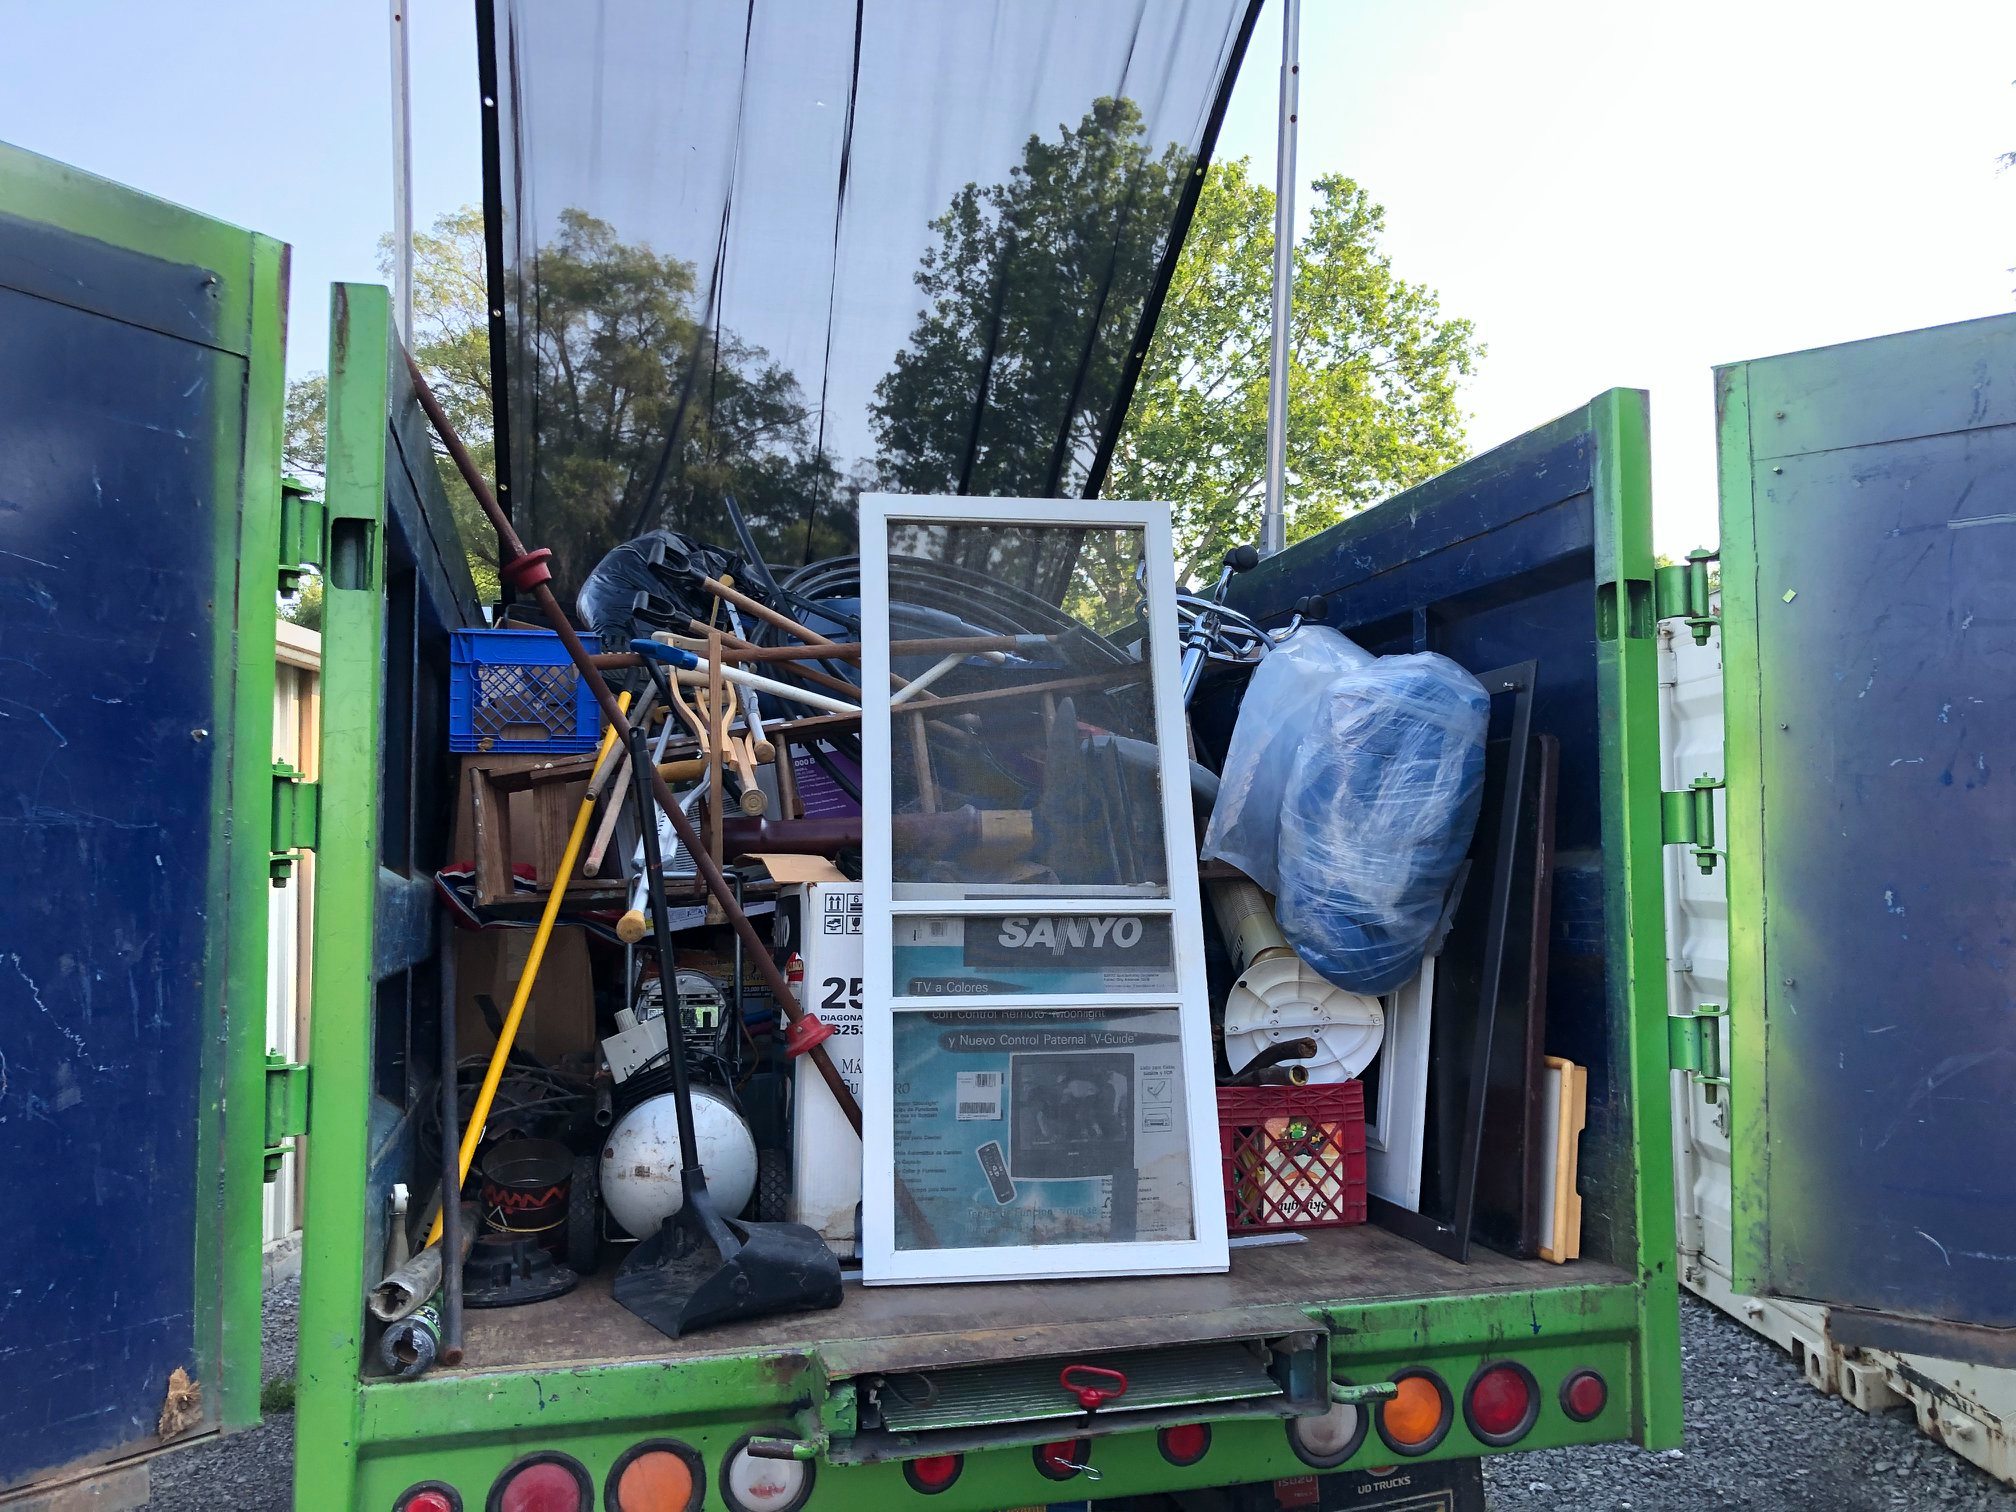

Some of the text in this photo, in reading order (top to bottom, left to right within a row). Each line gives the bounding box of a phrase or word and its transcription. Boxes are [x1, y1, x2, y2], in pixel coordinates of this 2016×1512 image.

[998, 916, 1143, 956] SANYO
[821, 976, 863, 1009] 25
[915, 982, 988, 993] TV a Colores
[833, 1024, 863, 1035] S25
[948, 1037, 956, 1048] y
[960, 1035, 996, 1046] Nuevo
[1000, 1034, 1039, 1046] Control
[1044, 1034, 1086, 1045] Paternal
[1357, 1475, 1411, 1495] UD TRUCKS
